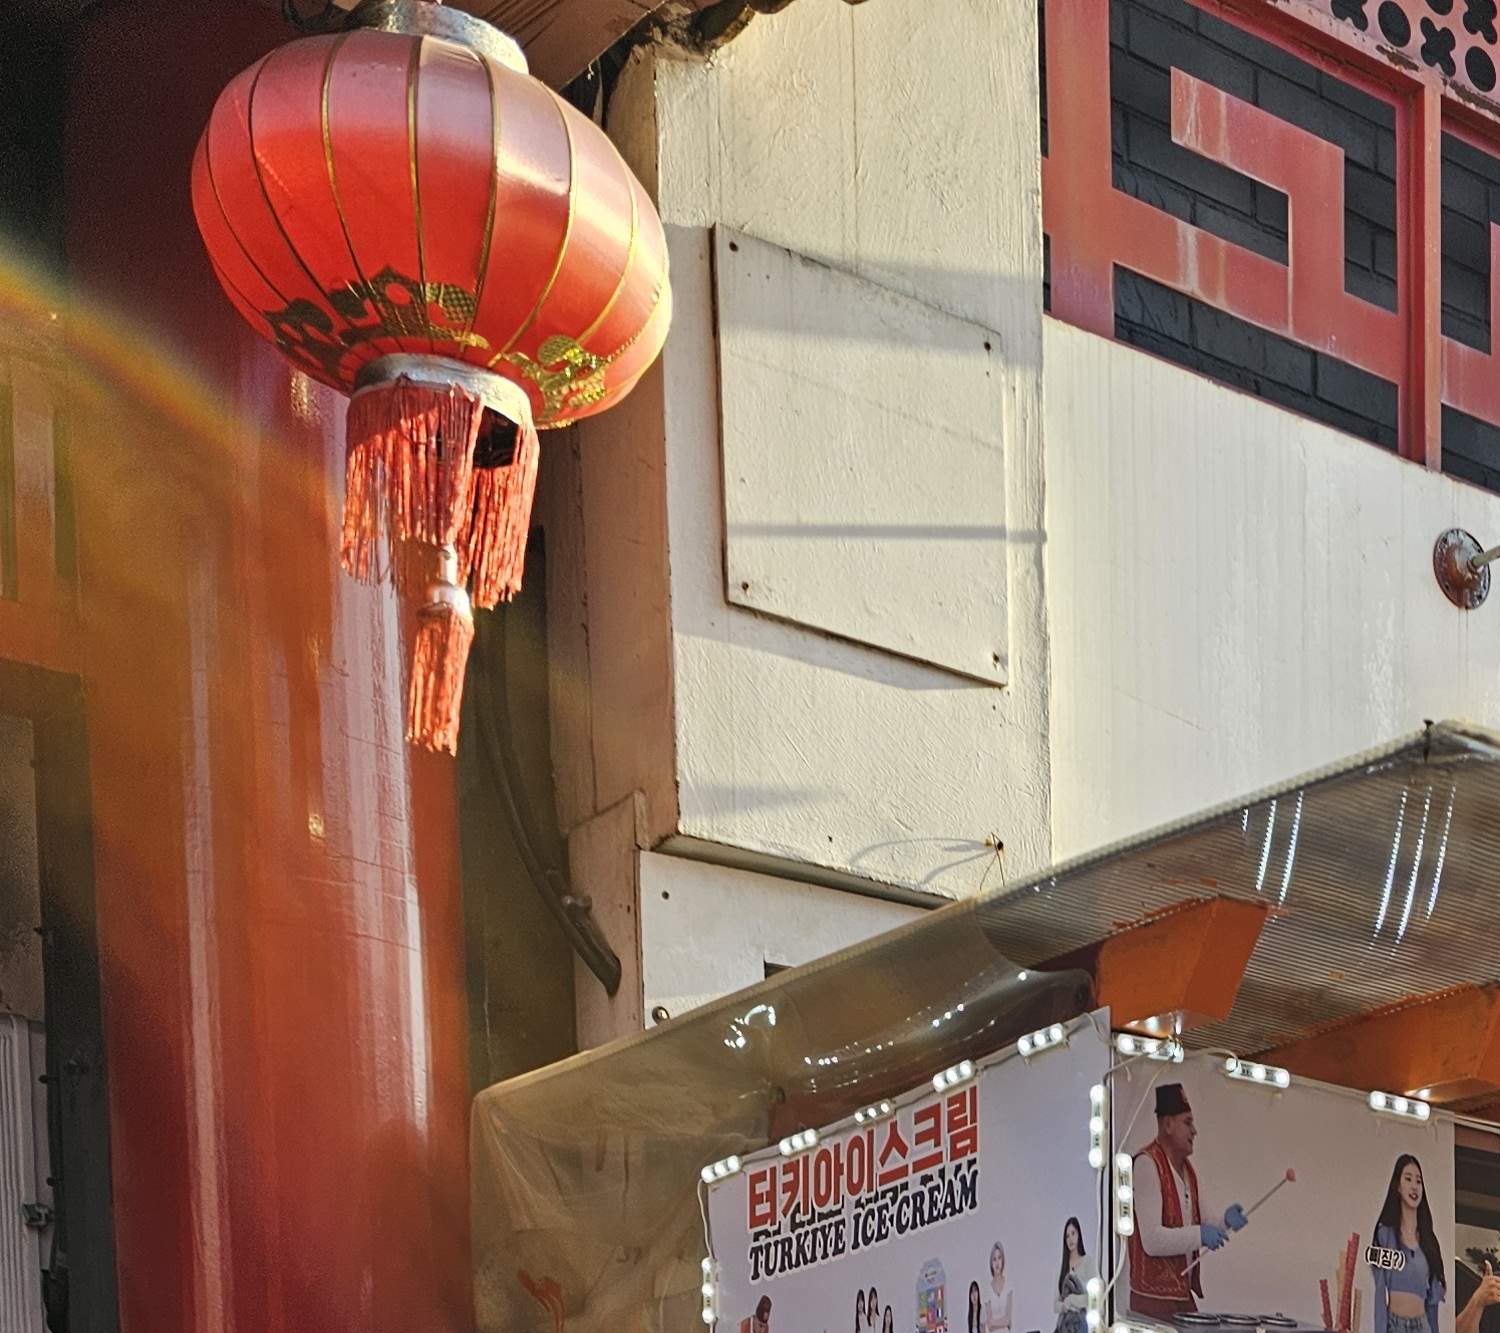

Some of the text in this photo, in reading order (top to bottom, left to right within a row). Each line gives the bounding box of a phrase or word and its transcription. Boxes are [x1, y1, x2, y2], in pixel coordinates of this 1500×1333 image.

[749, 1085, 978, 1229] 터키아이스크림
[750, 1169, 978, 1281] TURKIYE ICE CREAM
